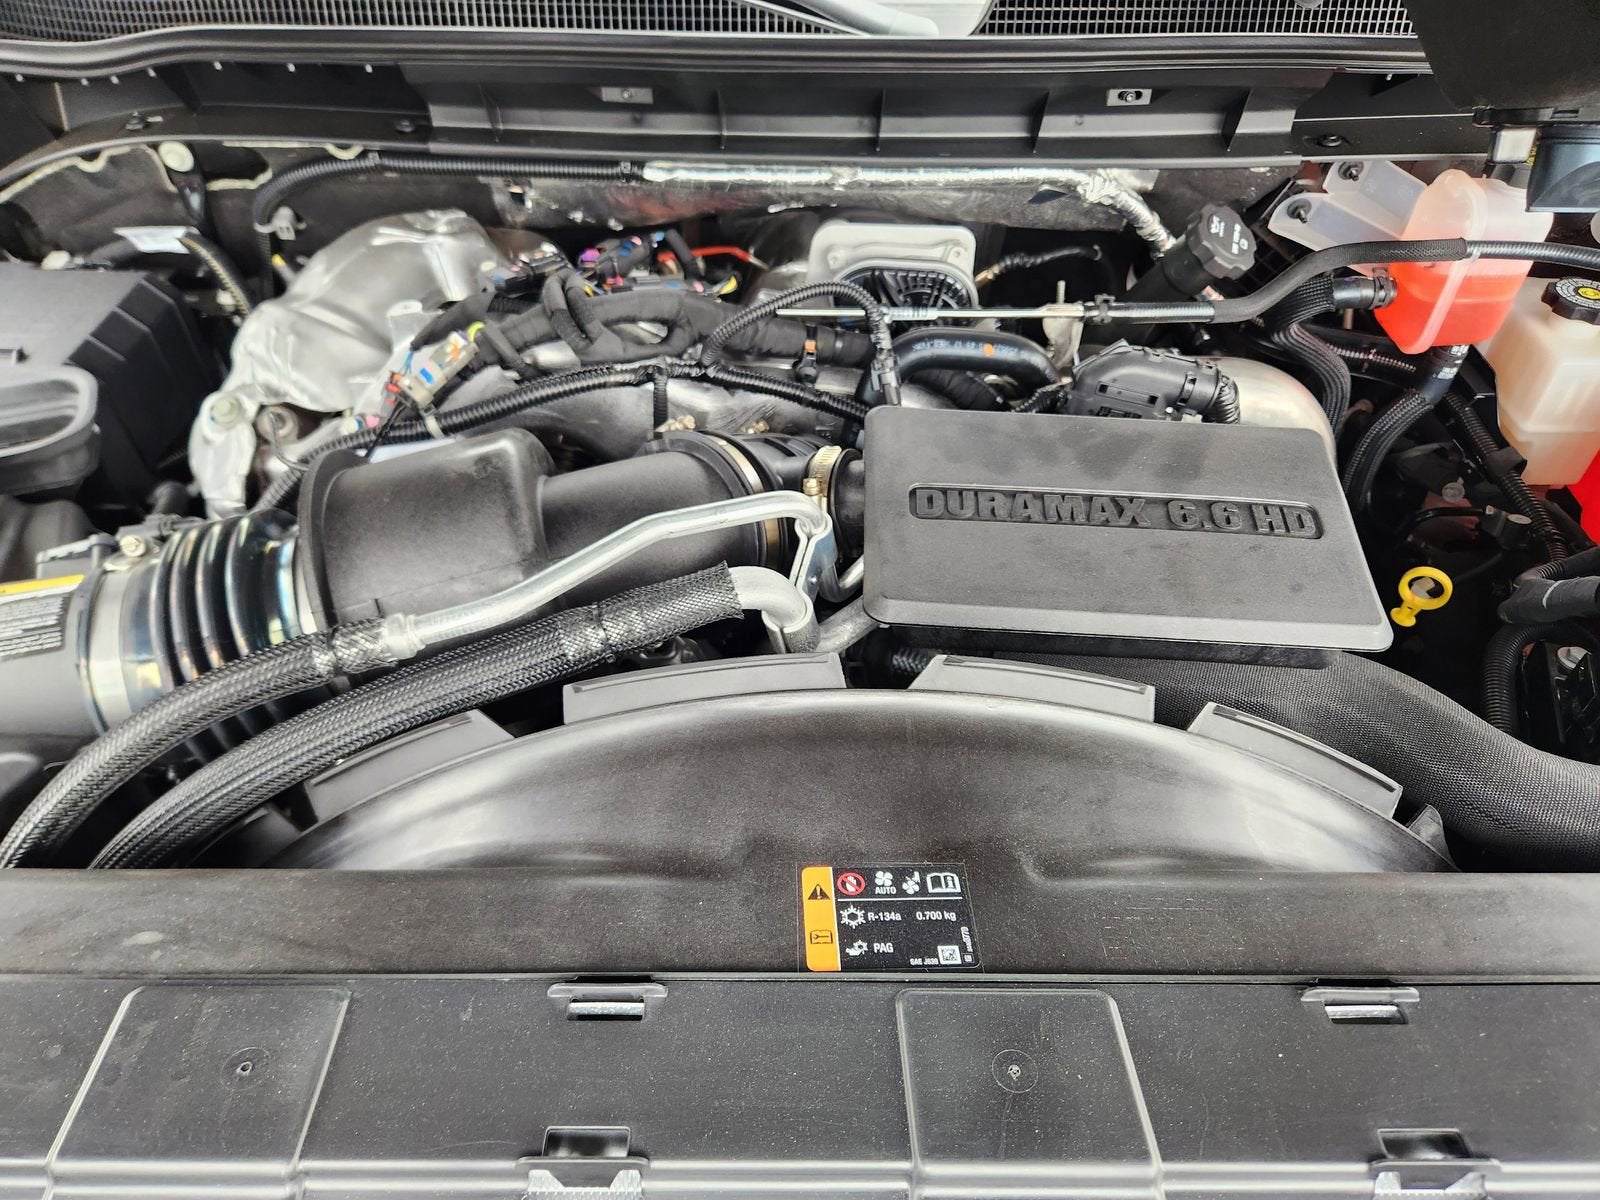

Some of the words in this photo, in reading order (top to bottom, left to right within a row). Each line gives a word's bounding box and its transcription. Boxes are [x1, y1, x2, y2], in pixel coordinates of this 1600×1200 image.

[915, 488, 1151, 527] DURAMAX
[1167, 500, 1243, 531] 6.6
[1250, 503, 1317, 537] HD
[875, 886, 896, 894] AUTO
[867, 911, 902, 920] R-134a
[916, 911, 942, 920] 0.700
[944, 910, 956, 921] kg
[873, 942, 894, 954] PAG
